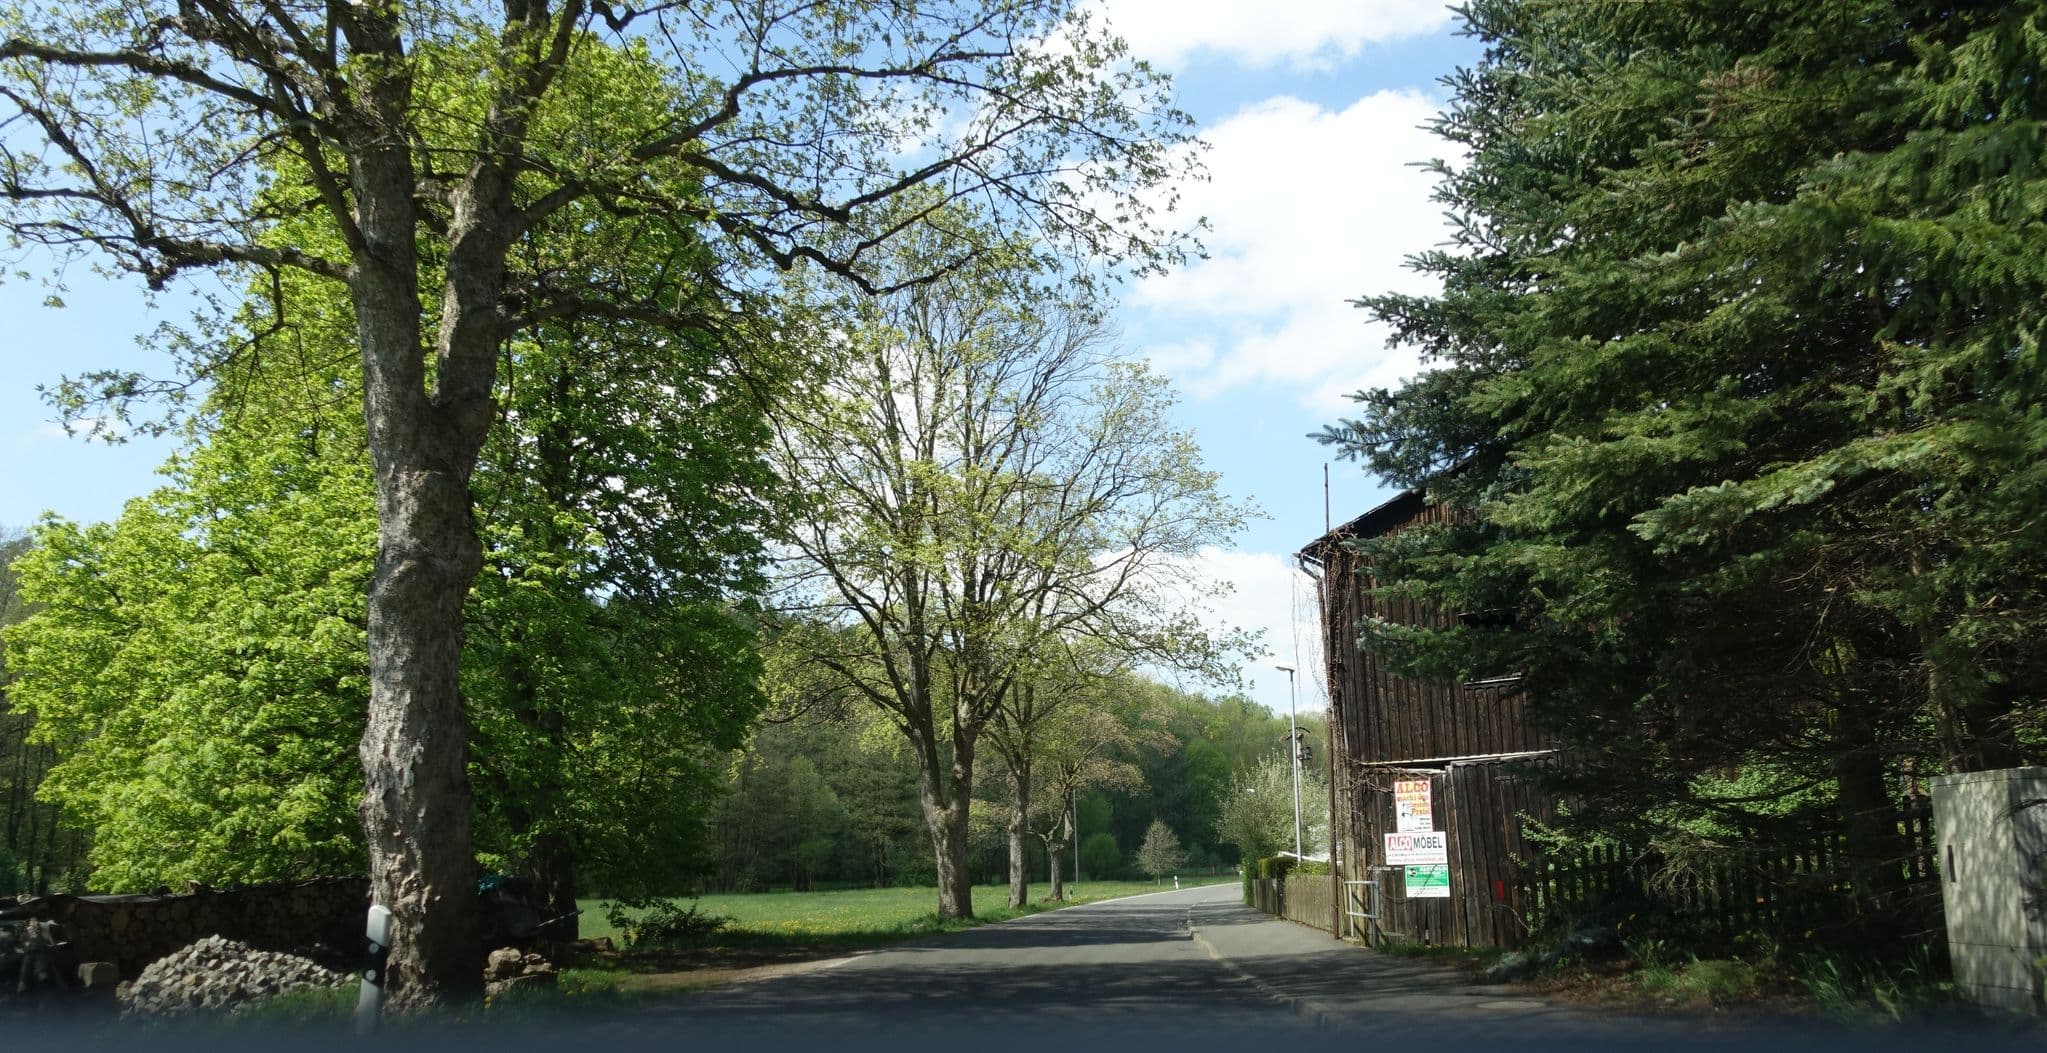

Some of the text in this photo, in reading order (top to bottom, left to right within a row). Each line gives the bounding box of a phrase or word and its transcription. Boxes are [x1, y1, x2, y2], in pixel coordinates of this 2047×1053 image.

[1397, 782, 1428, 793] ALCO
[1390, 834, 1443, 850] ALCO MÖBEL
